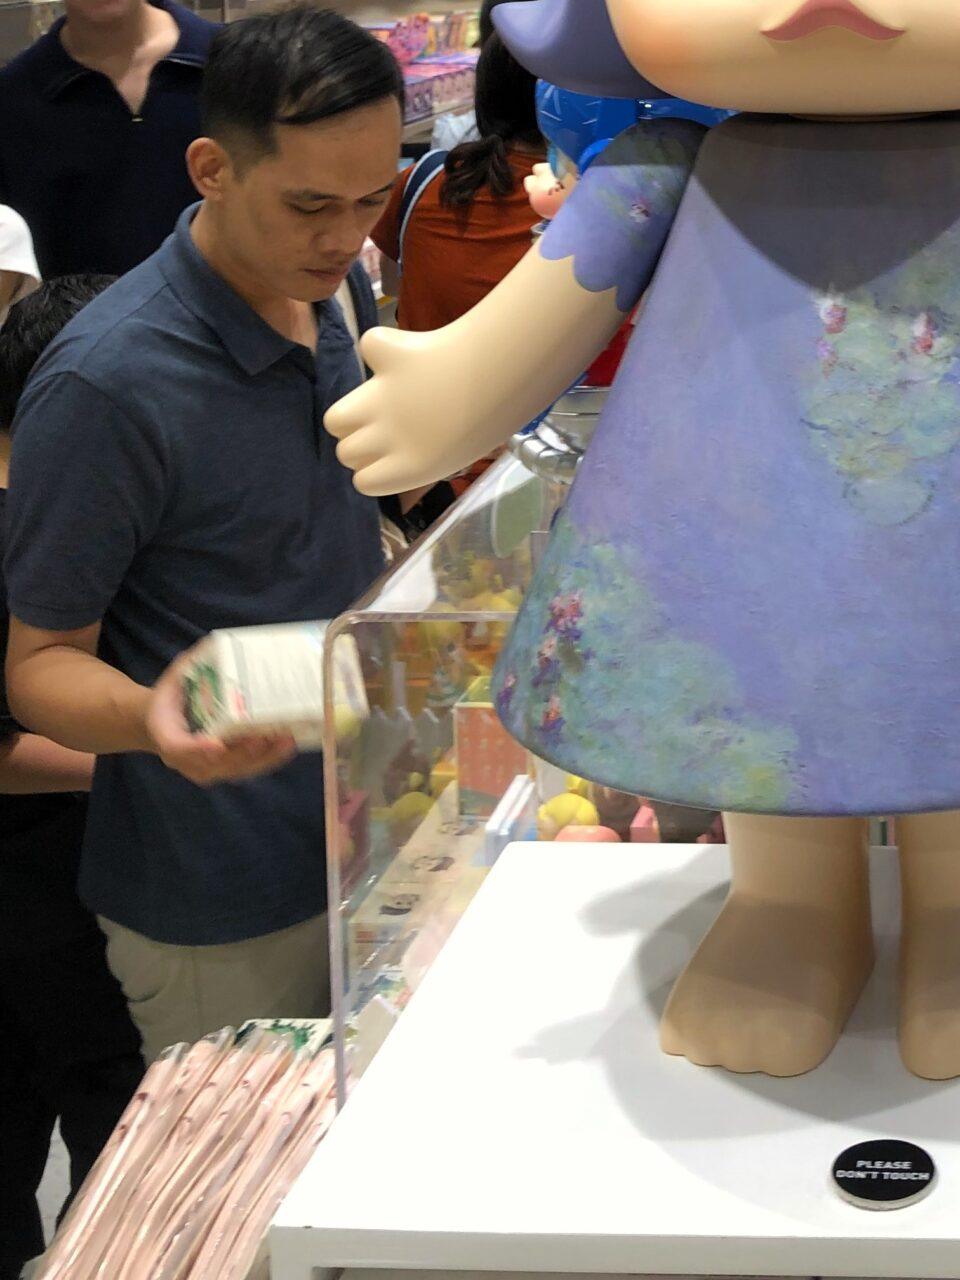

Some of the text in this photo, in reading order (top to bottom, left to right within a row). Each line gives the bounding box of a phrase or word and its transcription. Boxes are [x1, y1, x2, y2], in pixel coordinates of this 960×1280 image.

[856, 1160, 912, 1169] PLEASE
[835, 1170, 931, 1180] DON'T TOUCH
